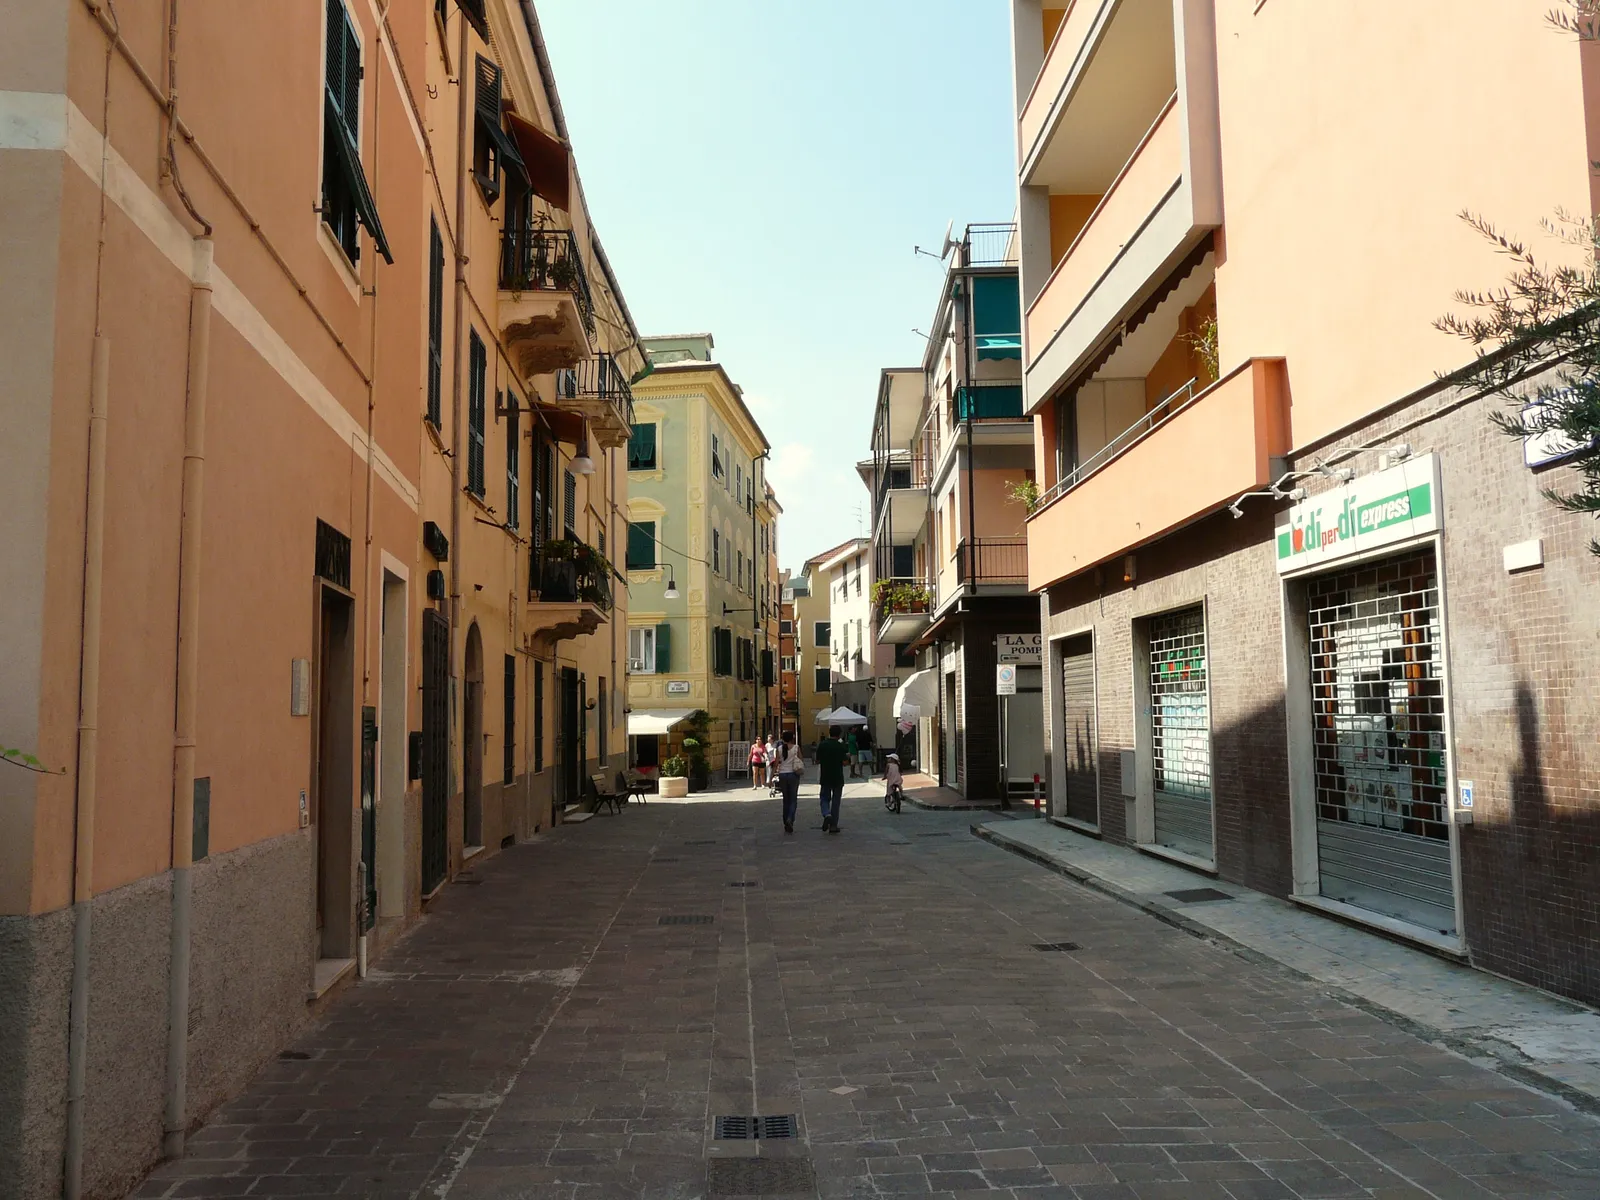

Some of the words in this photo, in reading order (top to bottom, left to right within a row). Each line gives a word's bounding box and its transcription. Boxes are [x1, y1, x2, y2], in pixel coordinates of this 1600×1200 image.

[1361, 495, 1410, 529] express
[1005, 635, 1025, 646] LA
[1011, 646, 1042, 655] POMP
